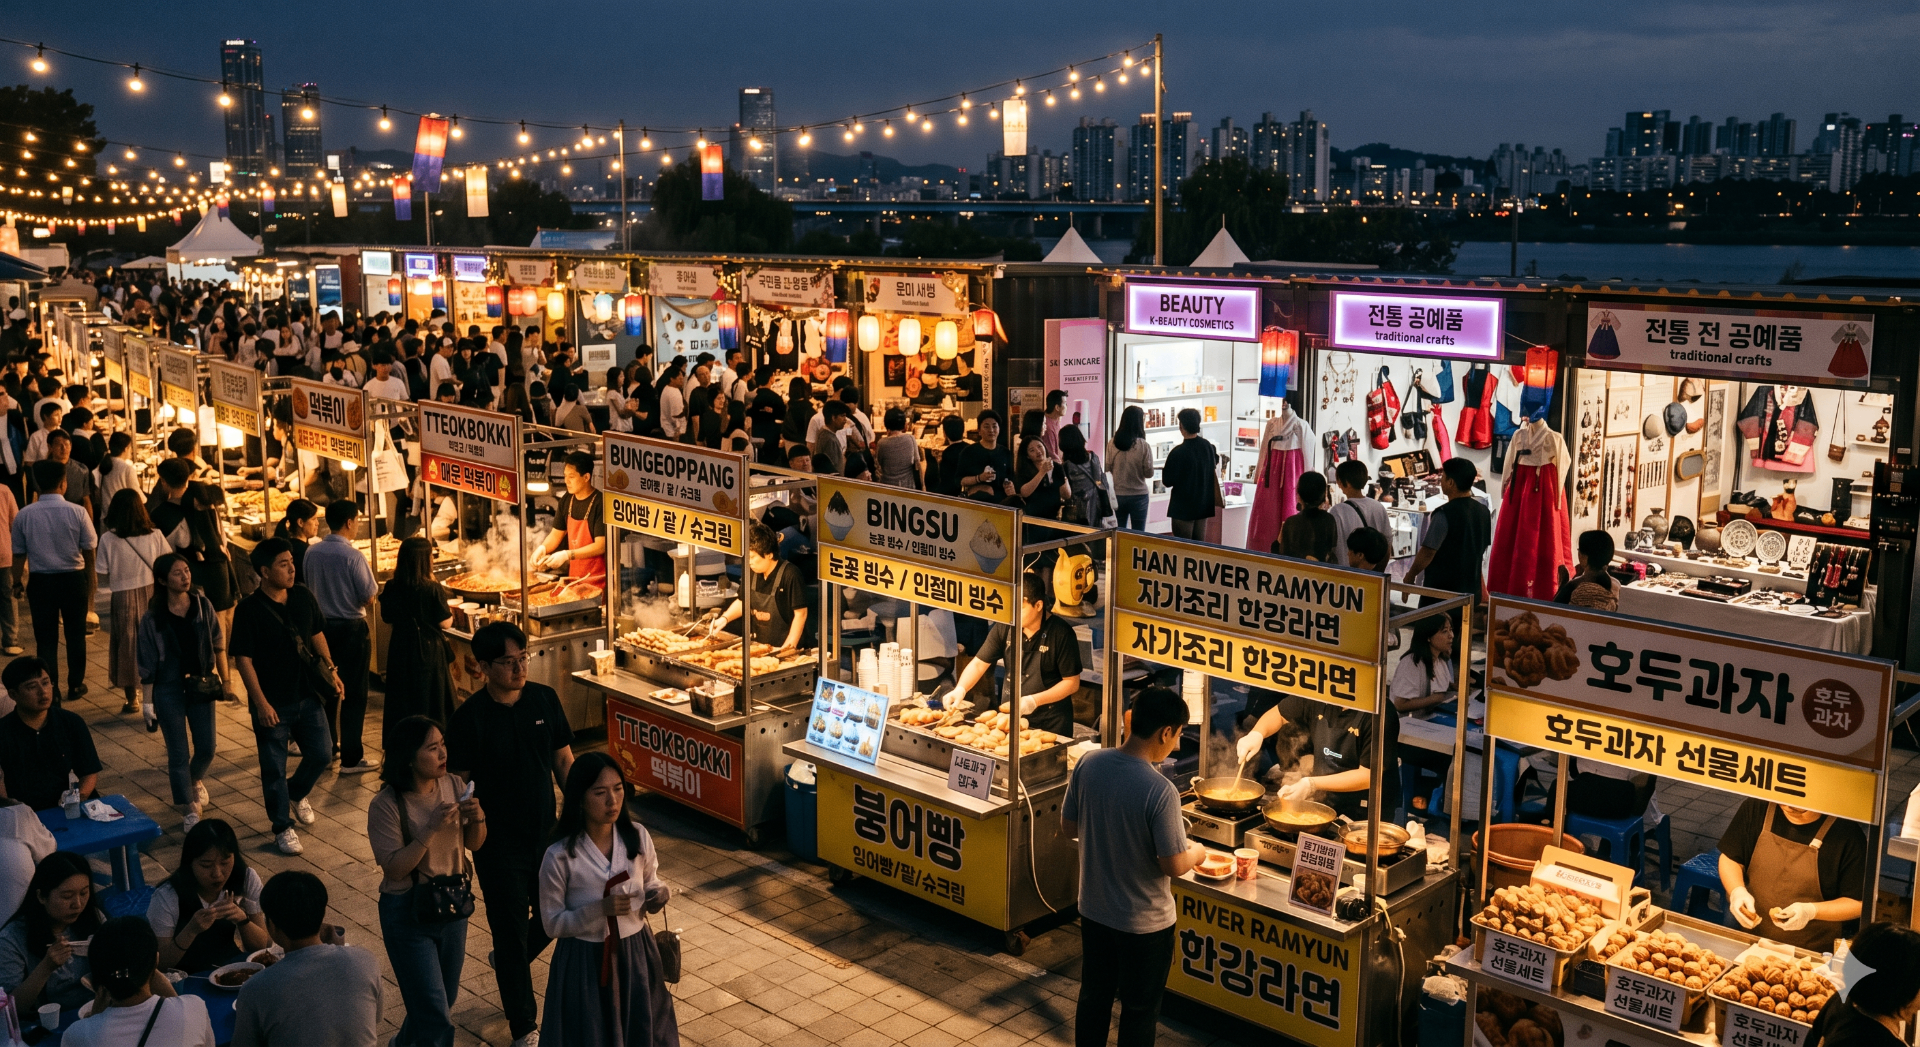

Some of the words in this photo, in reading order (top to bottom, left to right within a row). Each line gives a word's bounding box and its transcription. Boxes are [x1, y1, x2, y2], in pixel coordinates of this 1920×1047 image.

[1160, 294, 1225, 315] BEAUTY
[1368, 304, 1403, 328] 전통
[1408, 306, 1464, 332] 공예품
[1149, 316, 1188, 327] K-BEAUTY
[1190, 318, 1234, 330] COSMETICS
[1374, 330, 1424, 344] traditional
[1426, 336, 1455, 346] crafts
[1645, 318, 1690, 346] 전통
[1698, 322, 1720, 348] 전
[1728, 323, 1802, 352] 공예품
[1064, 358, 1100, 366] SKINCARE
[1670, 349, 1733, 364] traditional
[1735, 354, 1772, 366] crafts
[424, 410, 511, 448] TTEOKBOKKI
[440, 462, 461, 486] 매운
[610, 444, 734, 490] BUNGEOPPANG
[613, 499, 650, 528] 잉어빵
[663, 510, 676, 534] 팥
[690, 517, 732, 548] 슈크림
[866, 498, 958, 542] BINGSU
[888, 536, 904, 550] 빙수
[939, 546, 956, 561] 빙수
[830, 552, 859, 582] 눈꽃
[864, 560, 894, 589] 빙수
[914, 572, 963, 606] 인절미
[969, 584, 1004, 614] 빙수
[1132, 548, 1177, 577] HAN
[1184, 558, 1250, 591] RIVER
[1256, 570, 1364, 612] RAMYUN
[1138, 578, 1229, 622] 자가조리
[1238, 597, 1340, 646] 한강라면
[1132, 621, 1233, 672] 자가조리
[1242, 646, 1356, 702] 한강라면
[1586, 641, 1794, 726] 호두과자
[1813, 686, 1852, 710] 호두
[1812, 706, 1852, 731] 과자
[615, 712, 732, 782] TTEOKBOKKI
[1545, 714, 1666, 767] 호두과자
[1676, 744, 1807, 798] 선물세트
[852, 784, 966, 872] 붕어빵
[1182, 896, 1244, 935] RIVER
[1250, 918, 1349, 972] RAMYUN
[1492, 938, 1548, 966] 호두과자
[1179, 928, 1341, 1031] 한강라면
[1491, 955, 1544, 984] 선물세트
[1616, 976, 1676, 1005] 호두과자
[1614, 994, 1672, 1023] 선물세트
[1734, 1013, 1799, 1044] 호두과자
